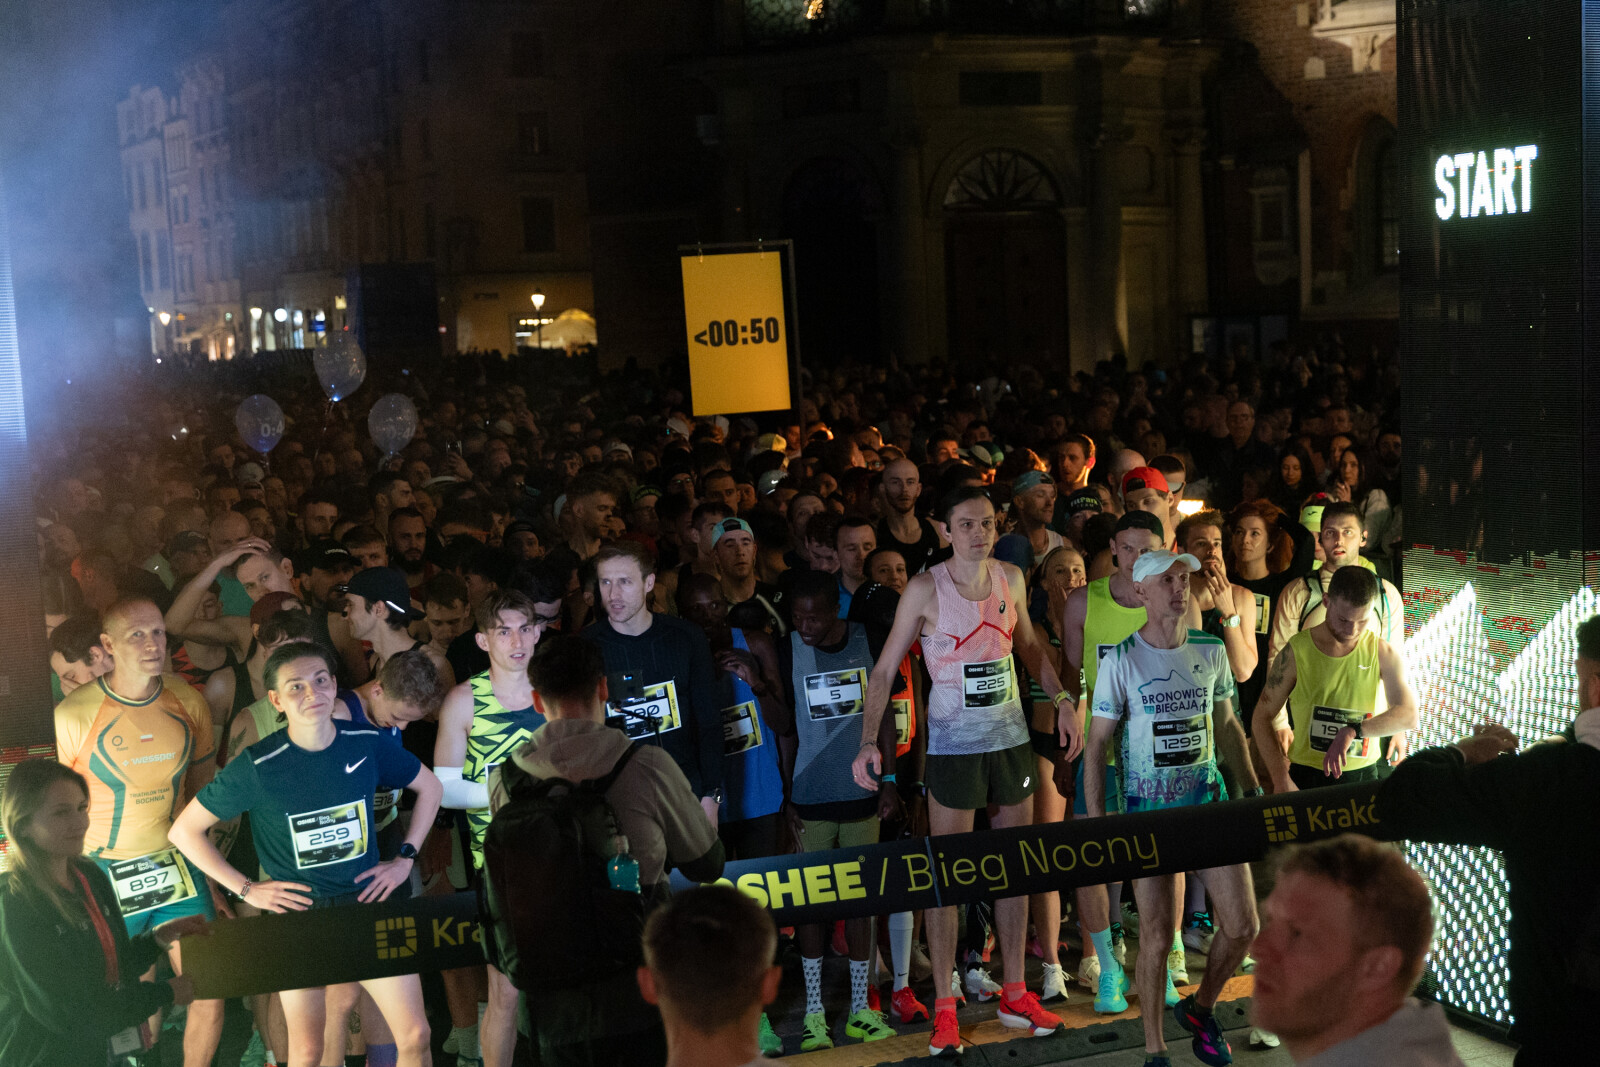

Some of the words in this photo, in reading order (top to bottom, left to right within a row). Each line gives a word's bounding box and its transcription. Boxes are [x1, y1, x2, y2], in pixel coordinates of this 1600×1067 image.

[1435, 145, 1537, 220] START
[694, 317, 779, 347] <00:50
[976, 676, 1005, 691] 225
[830, 689, 841, 700] 5
[1141, 687, 1208, 704] BRONOWICE
[1321, 724, 1339, 736] 19
[1161, 734, 1202, 750] 1299
[131, 752, 176, 765] wessper
[129, 790, 157, 798] TRIATHLON
[135, 794, 166, 805] BOCHNIA
[296, 817, 316, 826] OSHEE
[308, 827, 350, 846] 259
[901, 851, 1009, 892] Bieg
[1018, 832, 1160, 876] Nocny
[129, 871, 169, 892] 897
